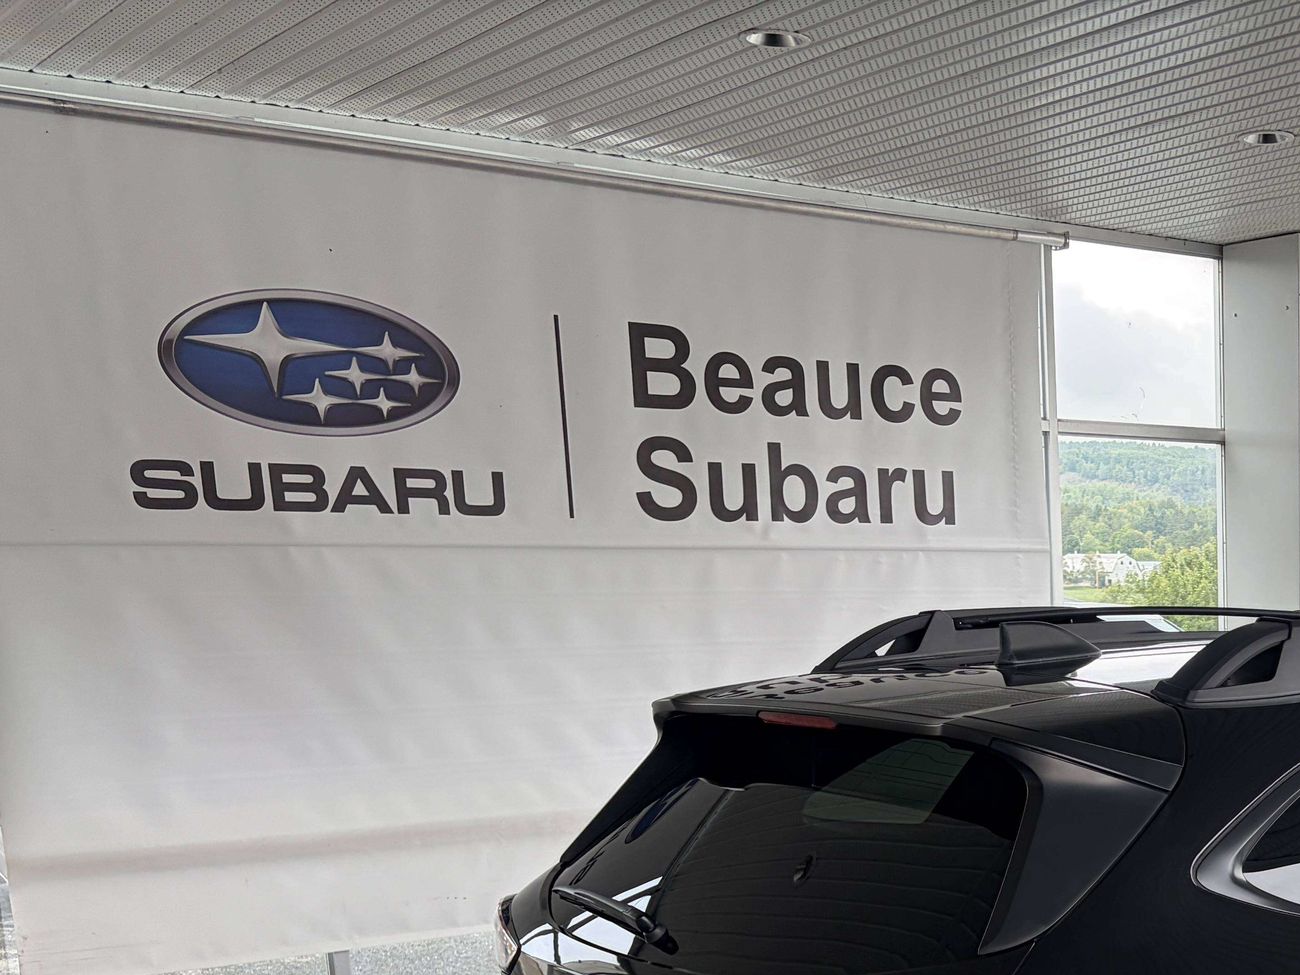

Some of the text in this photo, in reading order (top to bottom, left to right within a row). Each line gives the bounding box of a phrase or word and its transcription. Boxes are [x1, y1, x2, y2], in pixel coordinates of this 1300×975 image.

[628, 321, 962, 427] Beauce
[129, 459, 506, 517] SUBARU
[635, 435, 956, 526] Subaru
